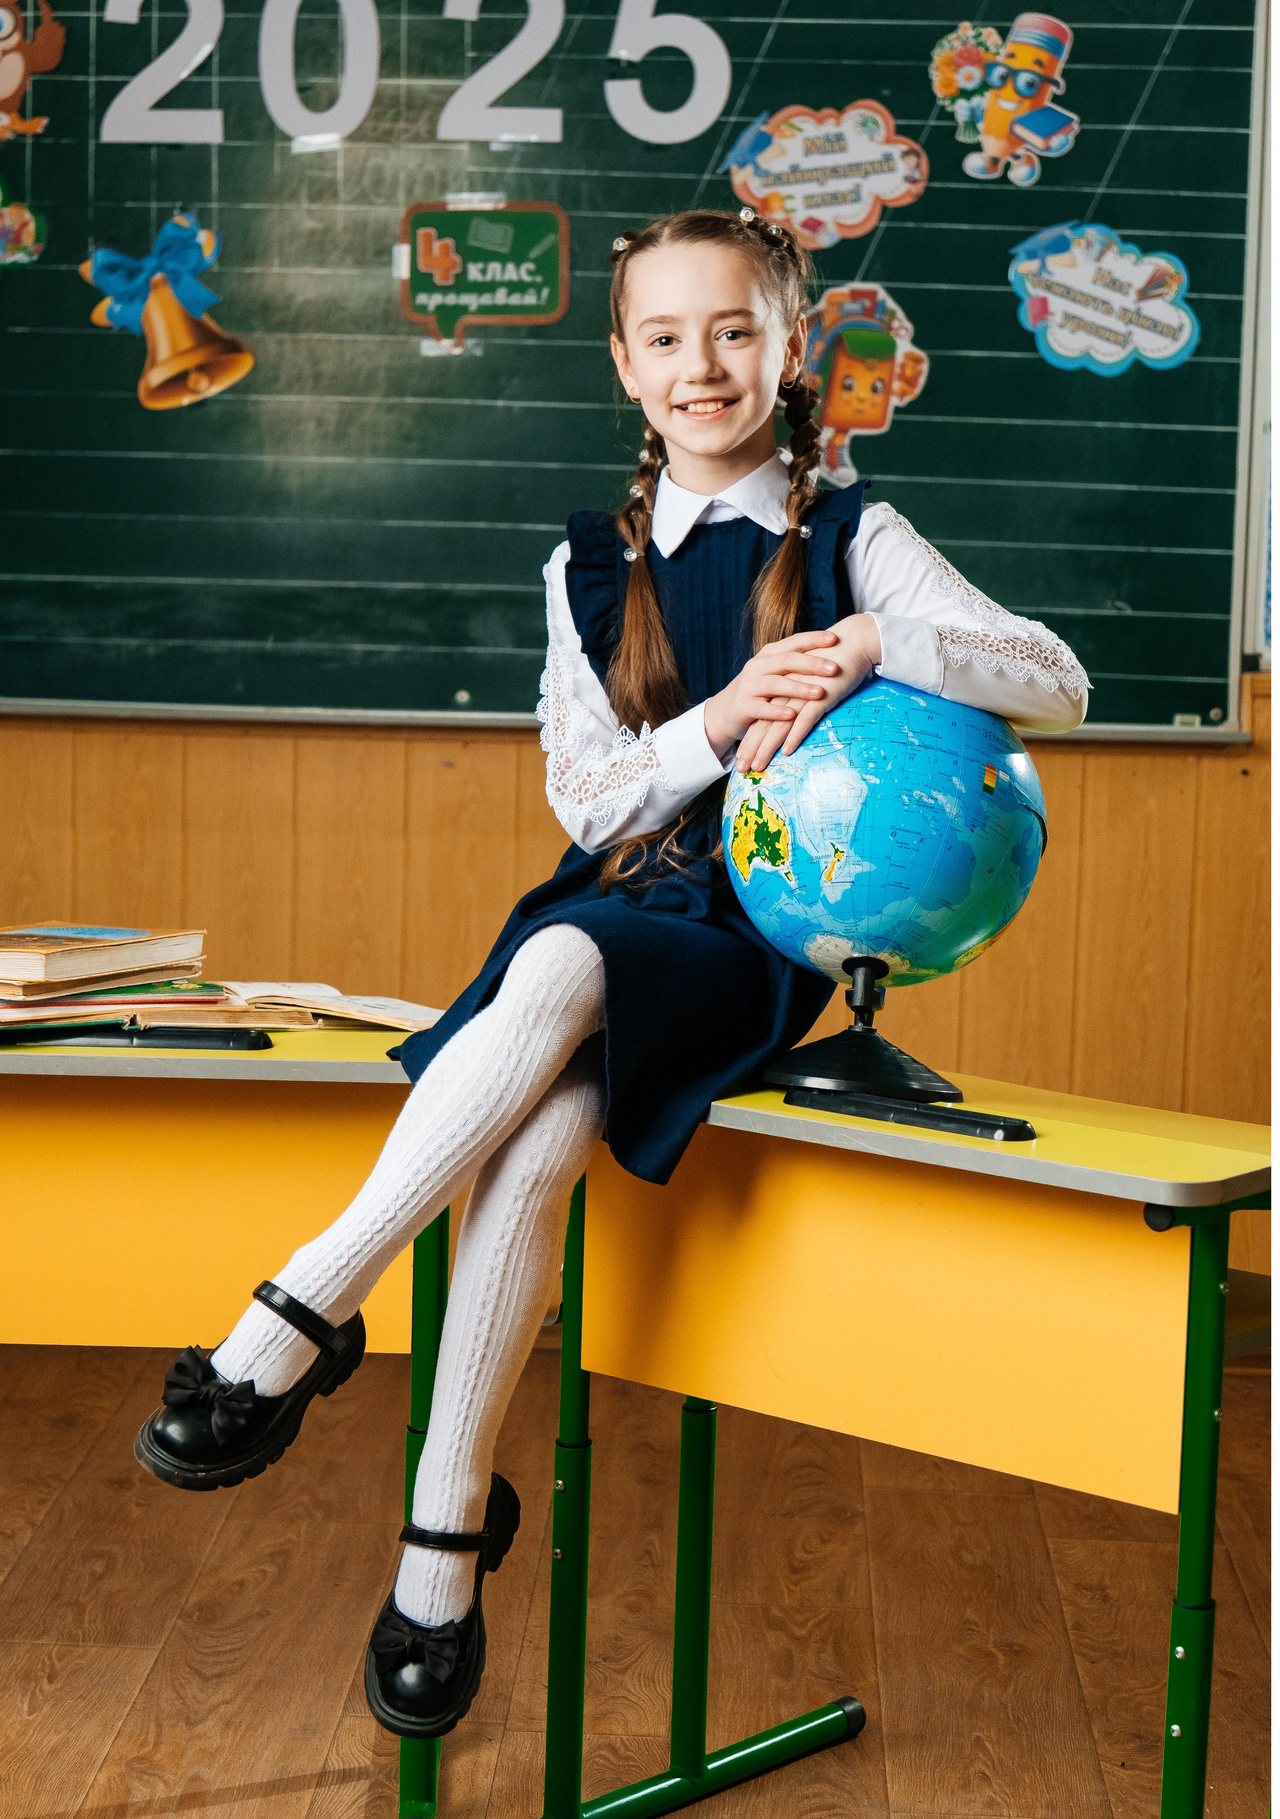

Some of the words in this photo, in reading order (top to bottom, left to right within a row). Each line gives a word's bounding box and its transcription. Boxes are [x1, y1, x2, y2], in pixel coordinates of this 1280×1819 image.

[802, 131, 848, 157] Мій
[417, 227, 463, 286] 4
[466, 261, 543, 283] КЛАС,
[1092, 266, 1133, 297] Нас
[414, 286, 550, 312] прощавай!
